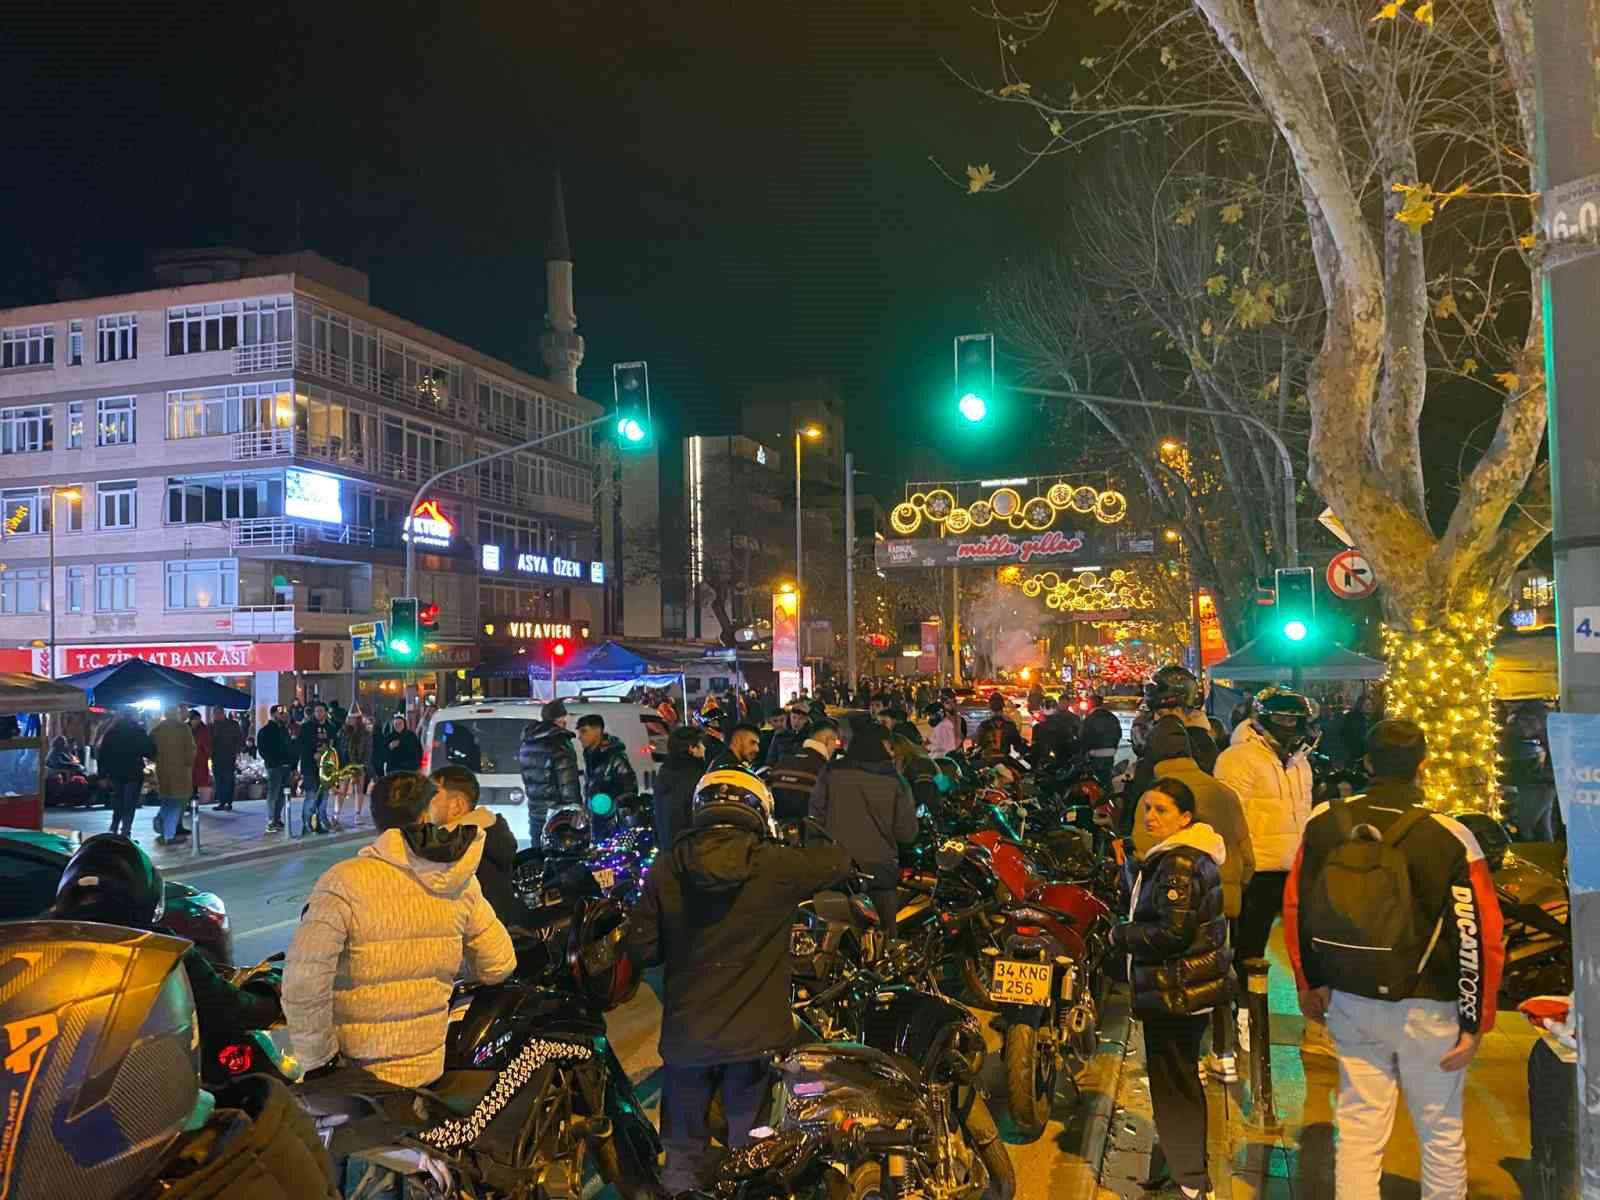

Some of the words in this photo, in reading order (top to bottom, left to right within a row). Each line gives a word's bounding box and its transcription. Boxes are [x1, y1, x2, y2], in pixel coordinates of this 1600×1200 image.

[170, 650, 248, 667] BANKASI
[997, 963, 1014, 977] 34
[1019, 965, 1048, 981] KNG
[1005, 980, 1033, 995] 256
